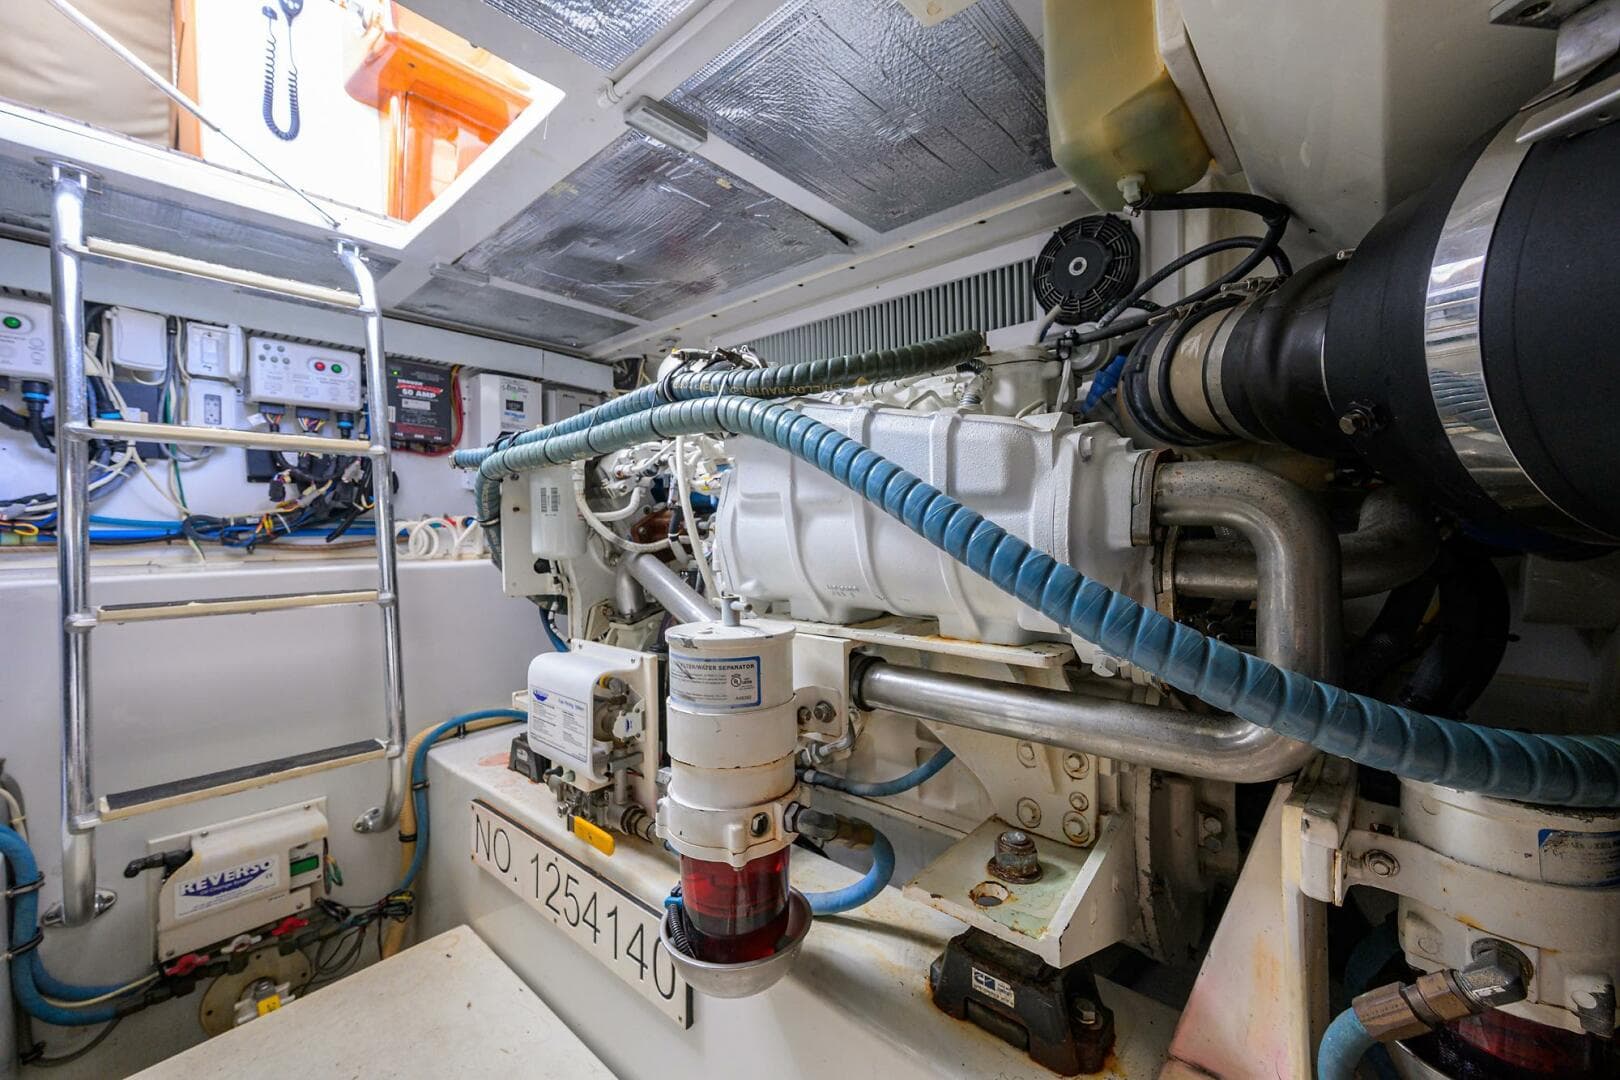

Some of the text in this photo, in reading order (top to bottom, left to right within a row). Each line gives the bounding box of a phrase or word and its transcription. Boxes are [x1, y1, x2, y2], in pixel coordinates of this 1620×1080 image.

[402, 388, 437, 398] 60 AMP
[718, 663, 755, 671] SEPARATOR
[181, 860, 272, 896] REVERSO
[475, 813, 676, 1000] NO. 1254140
